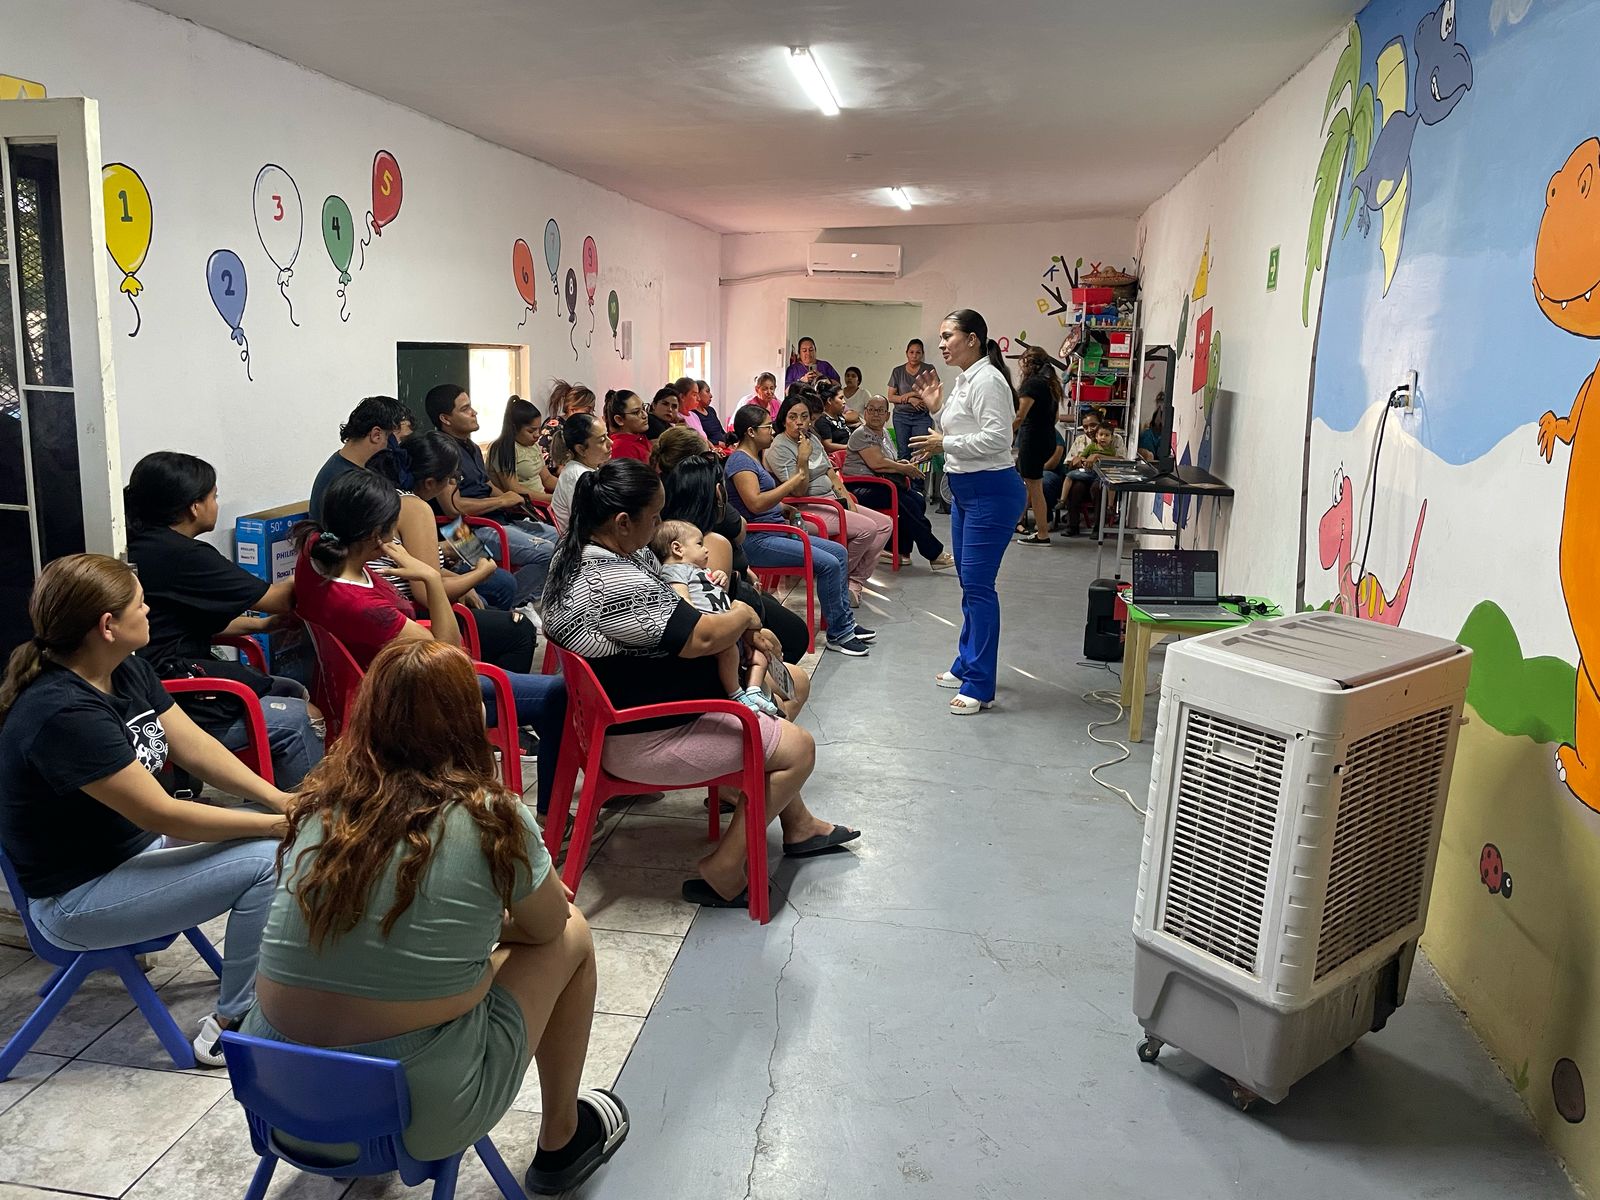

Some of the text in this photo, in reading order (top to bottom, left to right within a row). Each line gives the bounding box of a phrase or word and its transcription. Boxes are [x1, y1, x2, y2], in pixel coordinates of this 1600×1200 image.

[381, 170, 393, 196] 5
[118, 190, 133, 222] 1
[272, 195, 284, 221] 3
[331, 217, 341, 241] 4
[221, 269, 236, 296] 2
[522, 266, 529, 284] 6
[568, 278, 574, 295] 8
[1036, 298, 1050, 314] B
[998, 336, 1010, 352] Q
